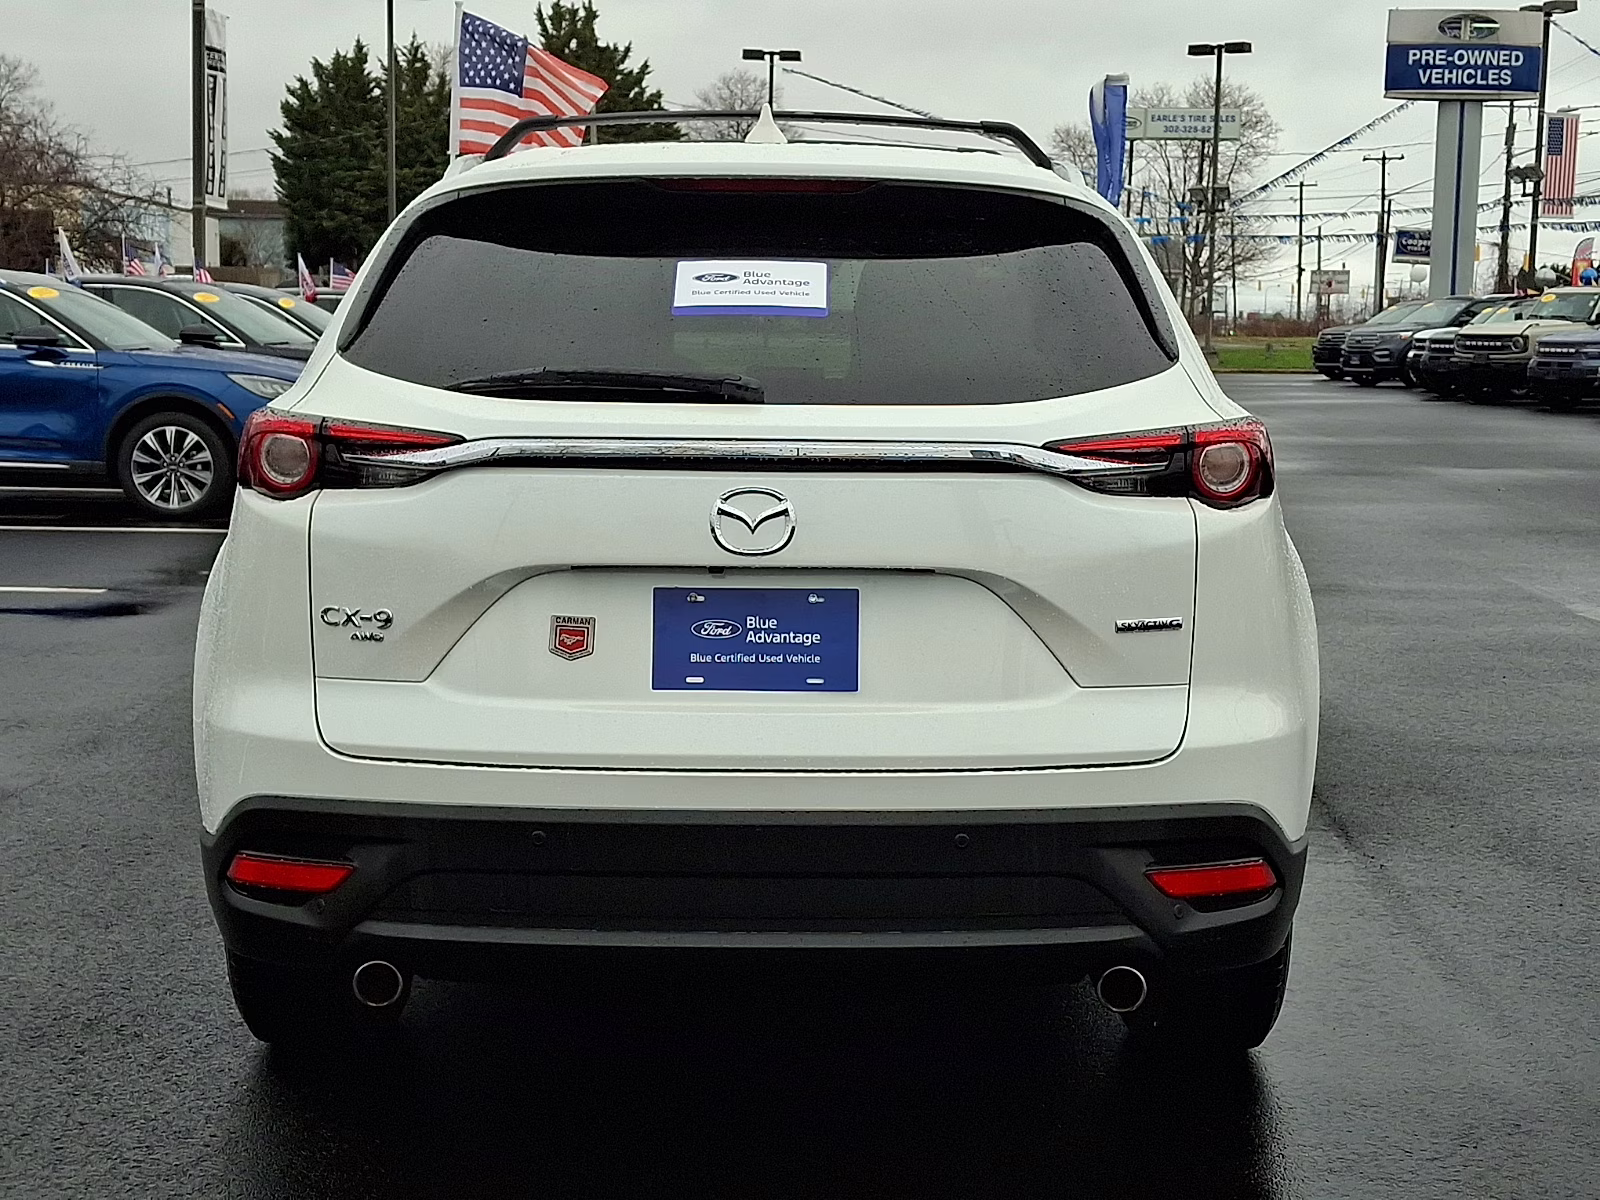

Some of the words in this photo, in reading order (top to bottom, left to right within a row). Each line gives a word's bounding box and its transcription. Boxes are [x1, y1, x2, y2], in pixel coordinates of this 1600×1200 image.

[1408, 49, 1524, 66] PRE-OWNED
[1418, 69, 1512, 85] VEHICLES
[1151, 114, 1185, 123] EARLE'S
[1189, 115, 1206, 123] TIRE
[1209, 115, 1236, 123] SLES
[1402, 237, 1431, 248] Cooper
[701, 273, 731, 283] Ford
[743, 270, 771, 278] Blue
[743, 278, 810, 288] Advantage
[320, 605, 394, 630] CX-9
[555, 616, 591, 625] CARMAN
[700, 621, 732, 637] Ford
[746, 616, 778, 629] Blue
[746, 631, 821, 646] Advantage
[690, 653, 712, 663] Blue
[714, 653, 756, 663] Certified
[759, 653, 783, 664] Used
[786, 653, 821, 664] Vehicle
